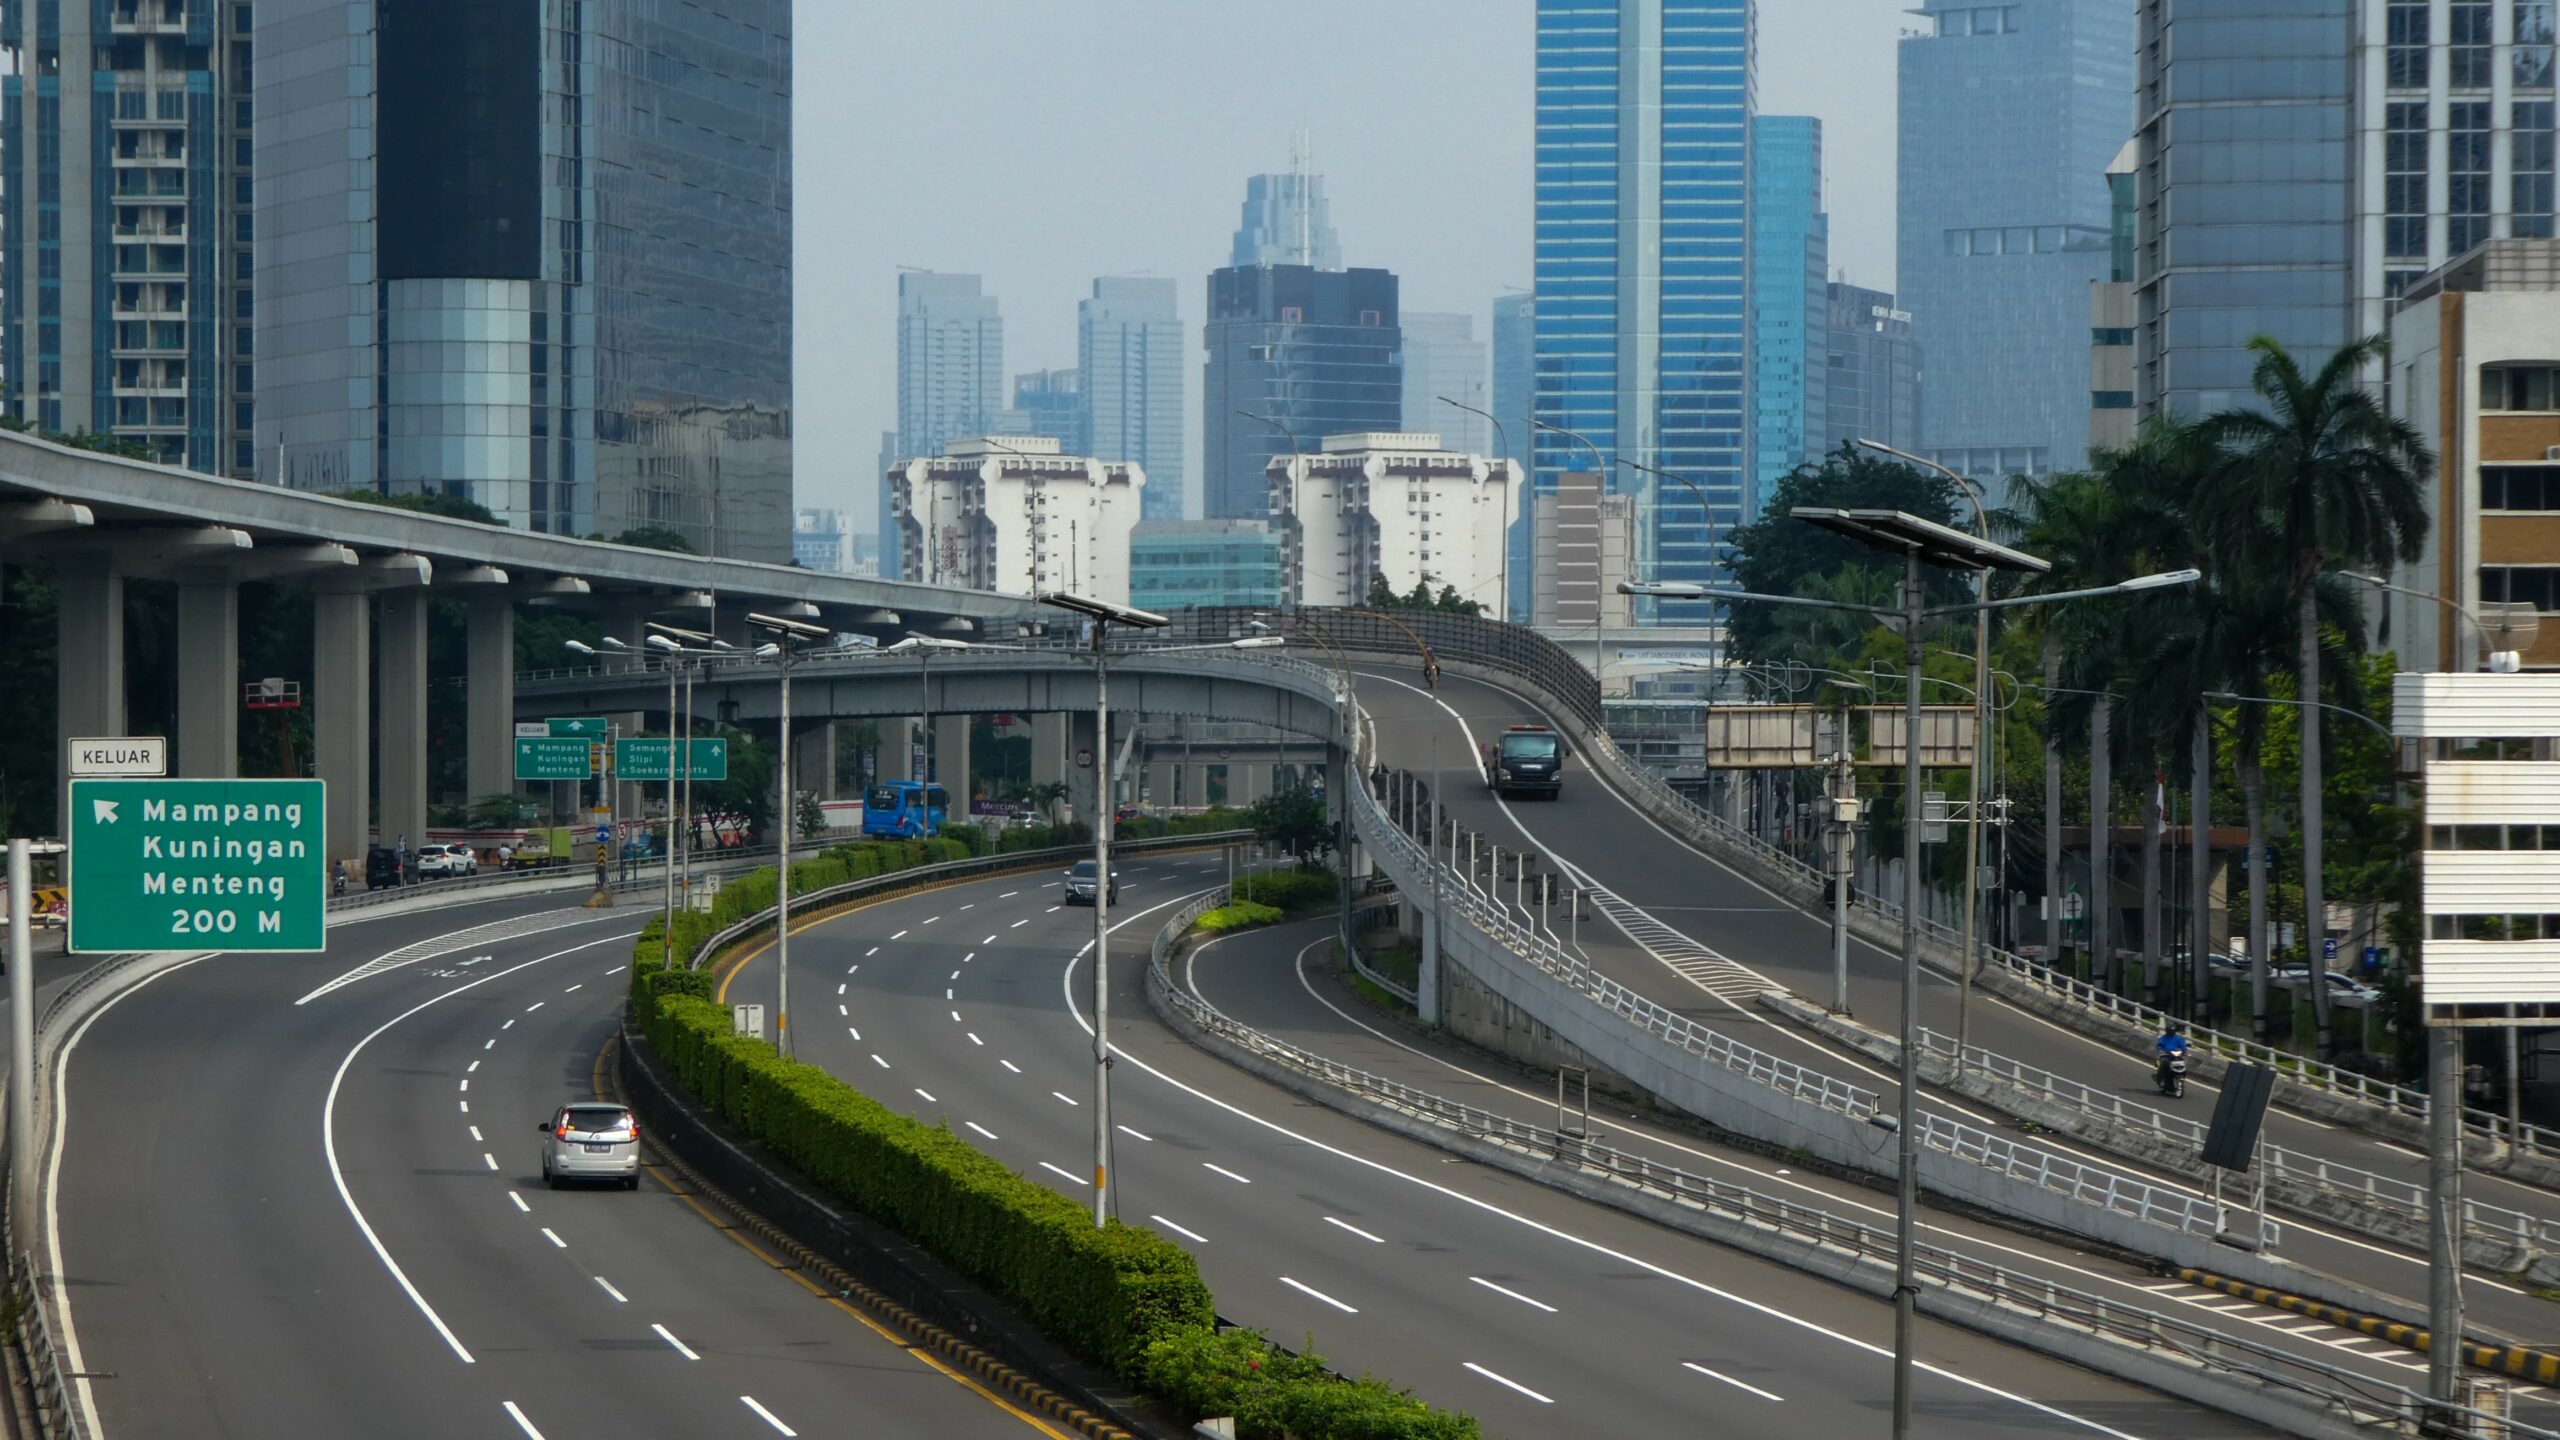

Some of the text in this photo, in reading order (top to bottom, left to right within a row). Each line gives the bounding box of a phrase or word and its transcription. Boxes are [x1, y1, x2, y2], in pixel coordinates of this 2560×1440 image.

[537, 744, 585, 753] Mampang
[83, 750, 151, 764] KELUAR
[537, 755, 586, 764] Kuningan
[629, 755, 653, 763] Slipi
[537, 766, 581, 775] Menteng
[143, 799, 302, 829] Mampang
[143, 835, 305, 865] Kuningan
[143, 871, 285, 901] Menteng
[172, 909, 281, 933] 200 M
